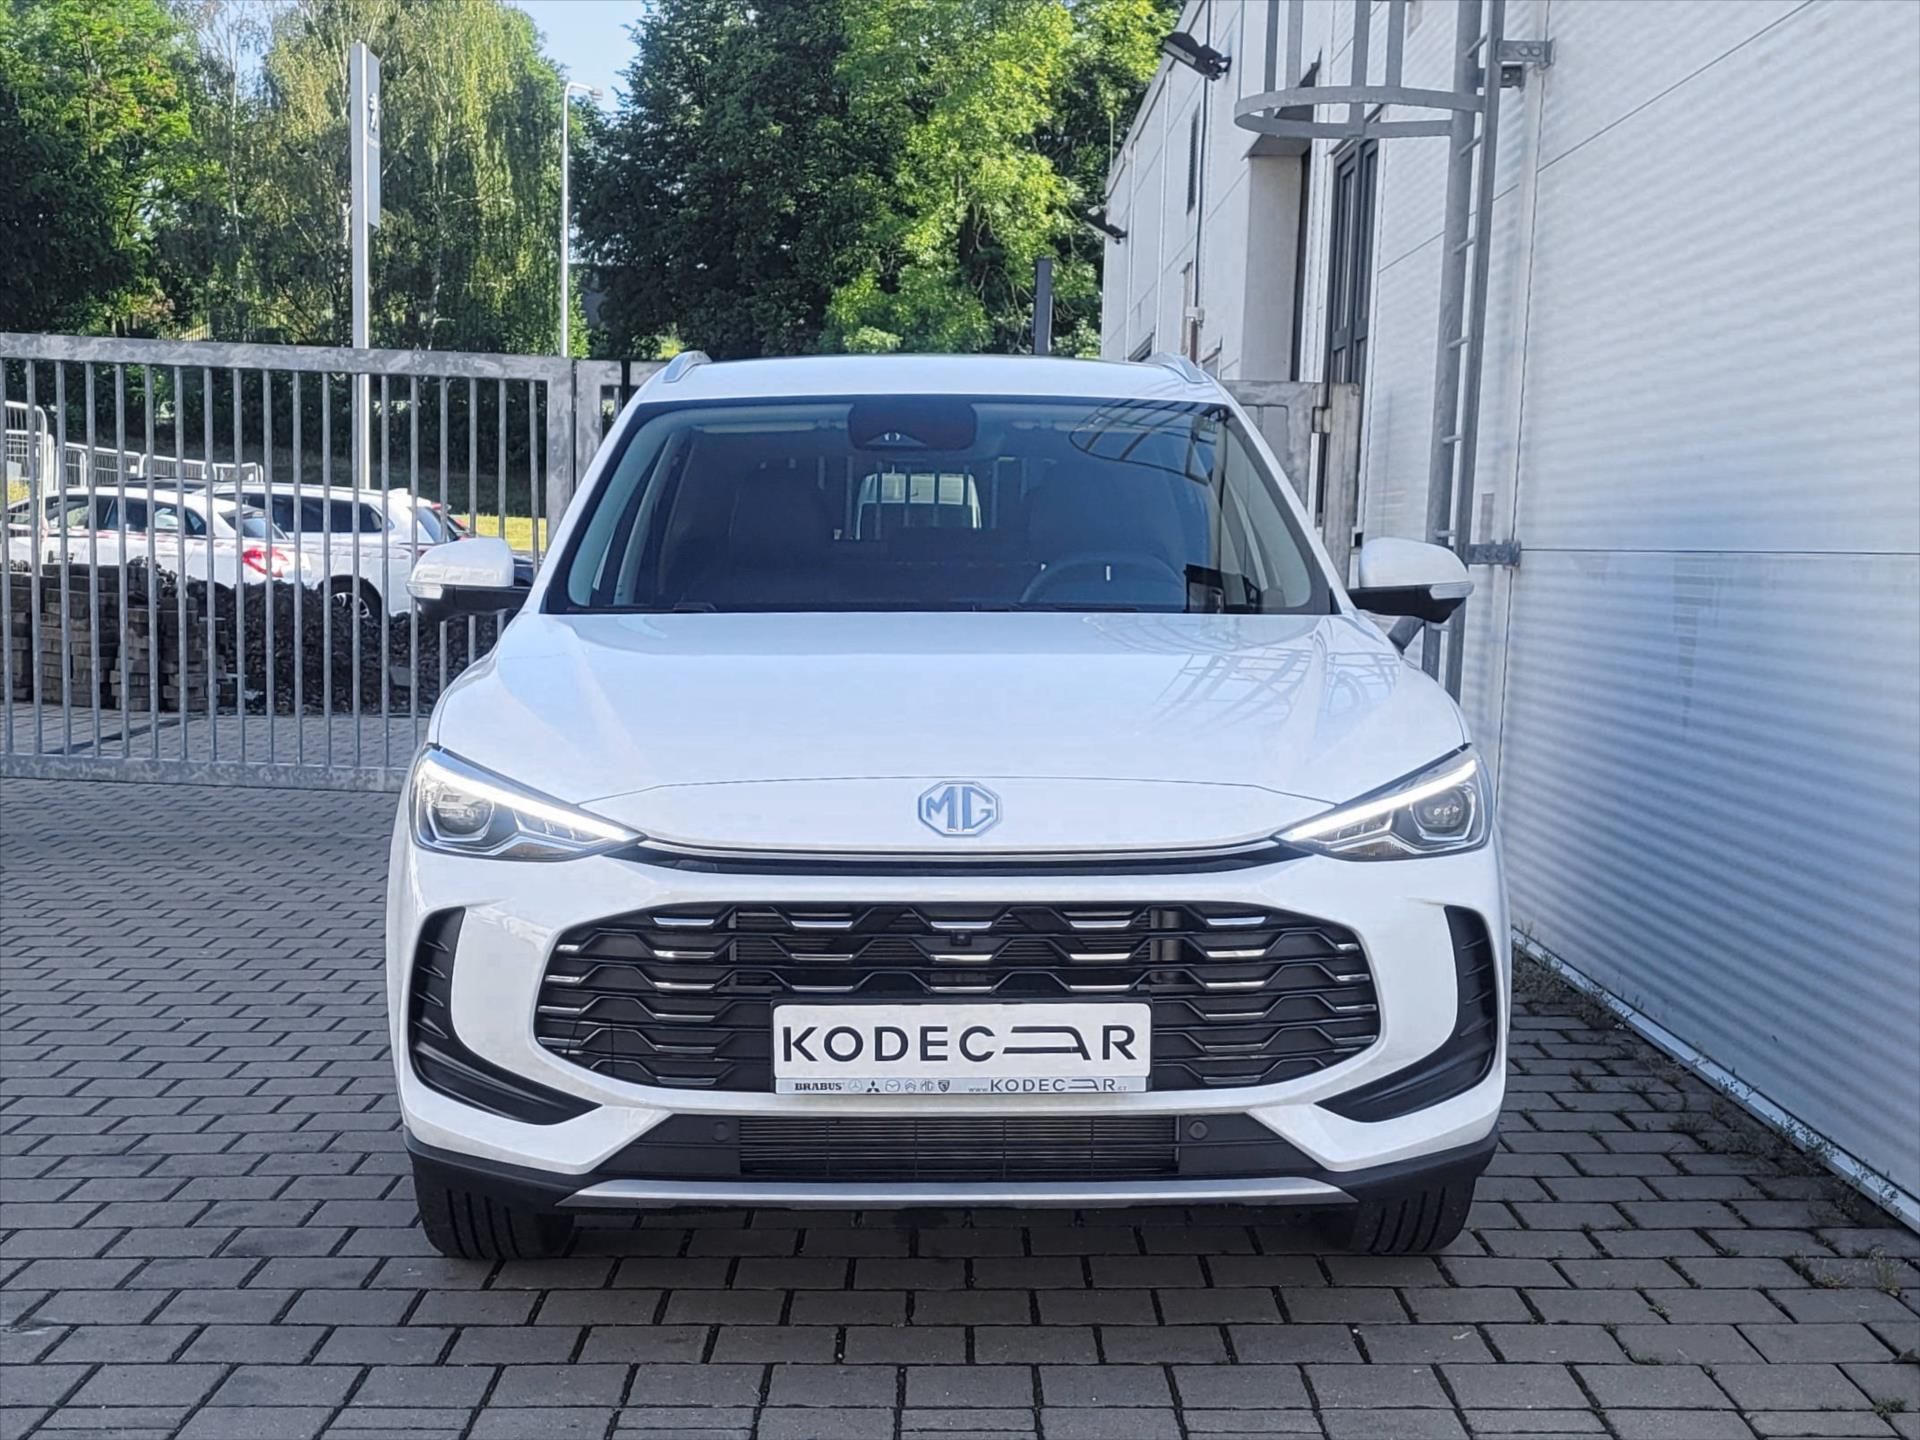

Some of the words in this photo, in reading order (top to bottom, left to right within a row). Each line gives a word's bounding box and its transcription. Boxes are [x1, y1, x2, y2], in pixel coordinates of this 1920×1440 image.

[925, 786, 994, 831] MG
[783, 1025, 1137, 1062] KODECAR
[795, 1082, 842, 1091] BRABUS
